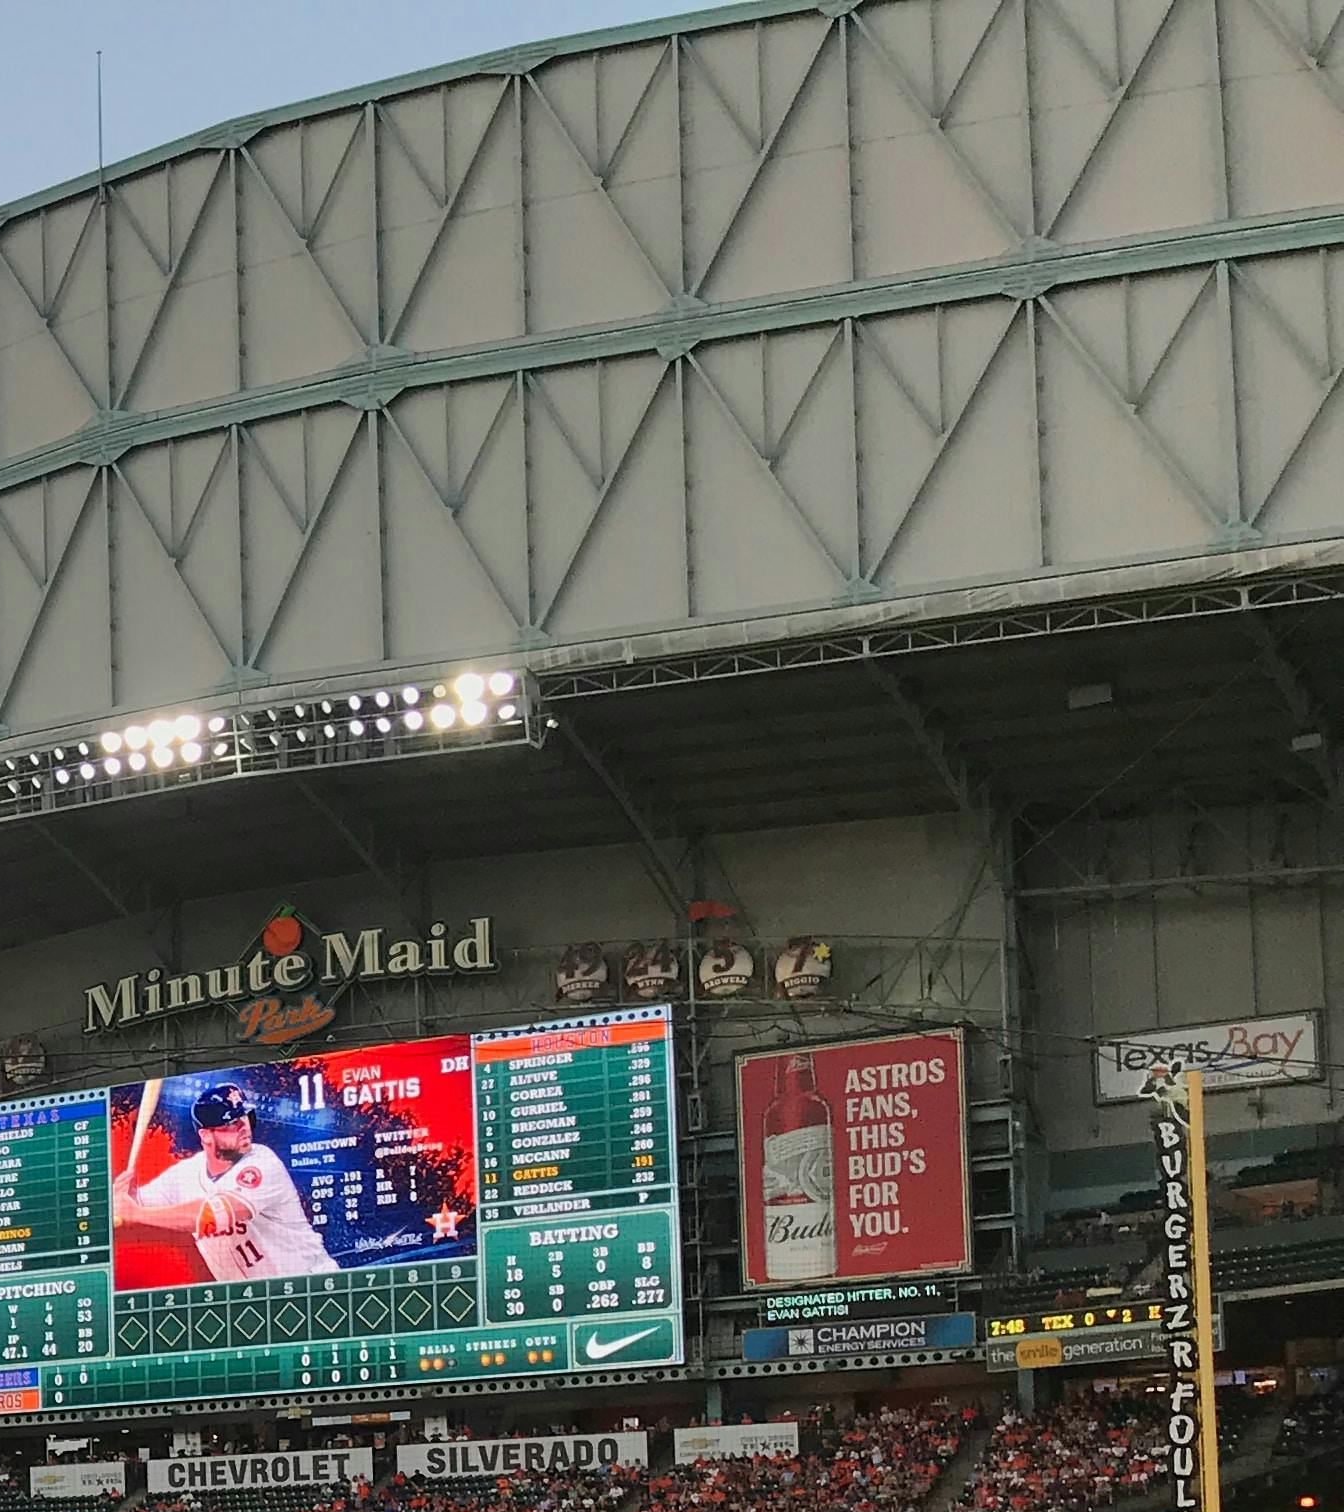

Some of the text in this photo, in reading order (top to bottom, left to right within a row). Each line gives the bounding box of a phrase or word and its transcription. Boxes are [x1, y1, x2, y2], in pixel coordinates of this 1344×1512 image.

[83, 917, 495, 1033] Minute Maid
[238, 995, 335, 1044] Park
[1228, 1027, 1303, 1066] Bay
[440, 1056, 469, 1073] DH
[509, 1053, 572, 1071] SPRINGER
[342, 1065, 381, 1083] EVAN
[510, 1071, 557, 1086] ALTUVE
[845, 1058, 945, 1094] ASTROS
[299, 1073, 325, 1112] 11
[343, 1077, 421, 1107] GATTIS
[510, 1086, 563, 1101] CORREA
[511, 1102, 567, 1117] GURRIEL
[846, 1091, 918, 1123] FANS,
[512, 1116, 576, 1133] BREGMAN
[512, 1132, 580, 1149] GONZALEZ
[847, 1122, 905, 1149] THIS
[291, 1137, 357, 1154] HOMETOWN
[512, 1149, 570, 1165] MCCANN
[848, 1148, 926, 1180] BUD'S
[312, 1175, 334, 1186] AVG
[513, 1166, 558, 1181] GATTIS
[312, 1188, 334, 1199] OPS
[513, 1181, 573, 1196] REDDICK
[849, 1183, 898, 1209] FOR
[514, 1199, 591, 1216] VERLANDER
[849, 1211, 910, 1239] YOU.
[1158, 1122, 1190, 1330] BURGERZ
[529, 1224, 619, 1246] BATTING
[586, 1289, 664, 1309] .262 .277
[766, 1285, 920, 1309] DESIGNATED HITTER, NO.
[767, 1307, 800, 1321] EVAN
[1042, 1314, 1073, 1331] TEX
[817, 1321, 925, 1343] CHAMPION
[2, 1346, 28, 1359] 47.1
[465, 1335, 557, 1352] STRIKES OUTS
[818, 1337, 926, 1353] ENERGY SERVICES
[991, 1336, 1142, 1364] the generation
[426, 1438, 619, 1476] SILVERADO
[168, 1453, 350, 1487] CHEVROLET
